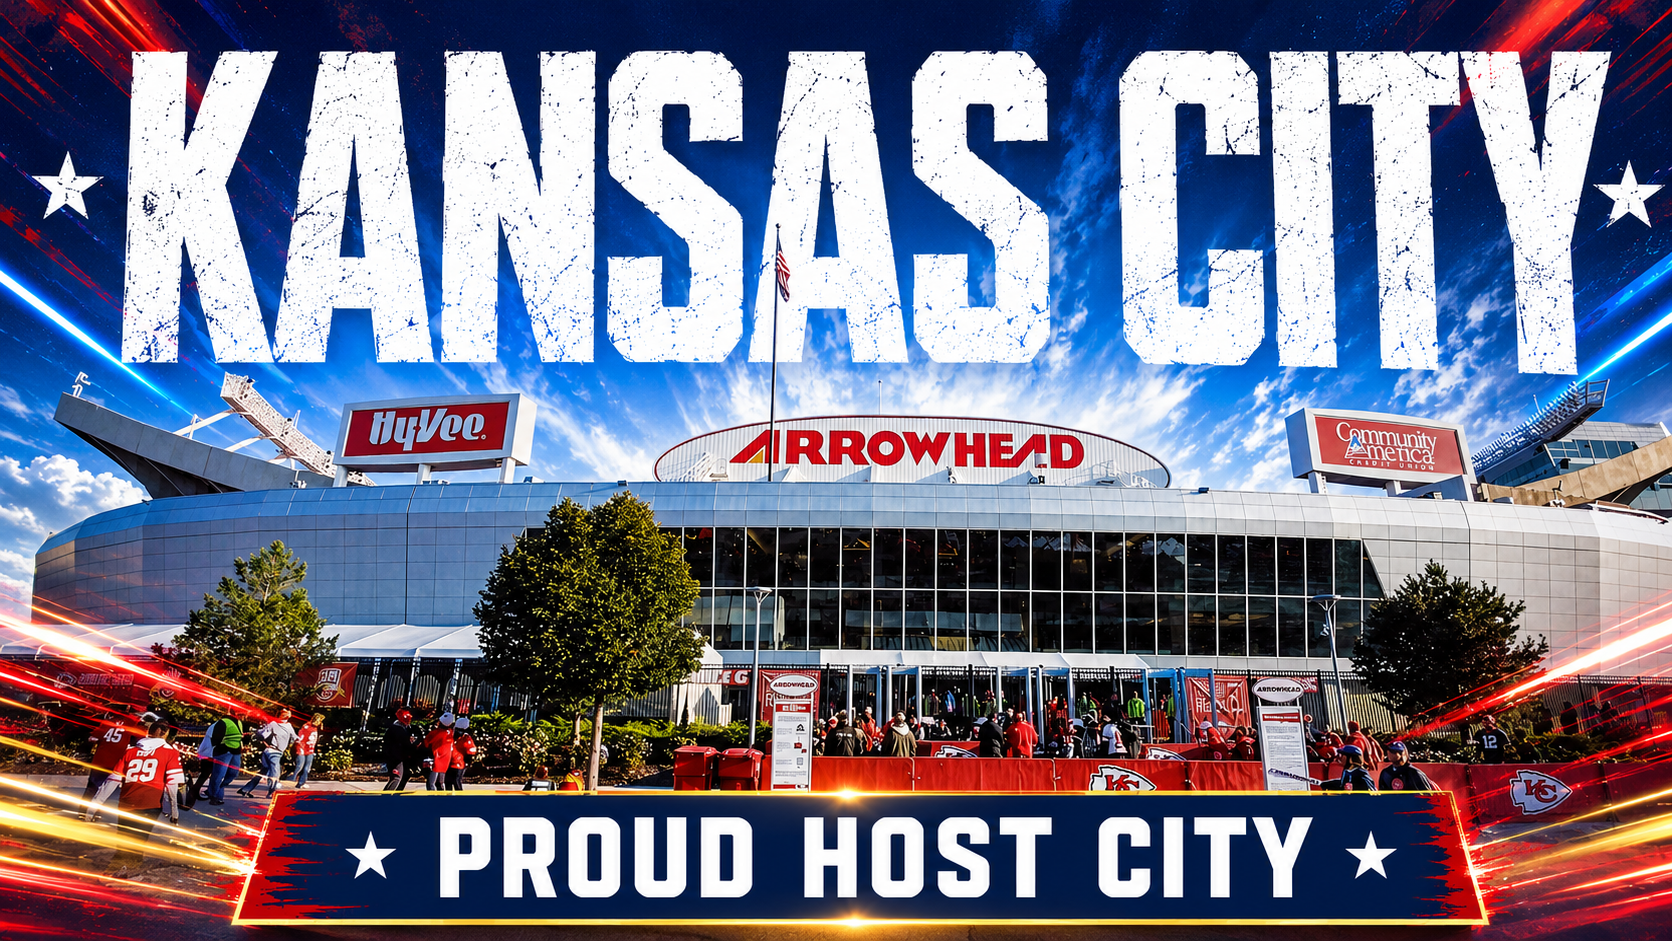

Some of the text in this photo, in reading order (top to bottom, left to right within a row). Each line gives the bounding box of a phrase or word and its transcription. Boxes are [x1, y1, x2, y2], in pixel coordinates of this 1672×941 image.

[729, 429, 1085, 469] ARROWHEAD
[1336, 422, 1437, 456] Community
[1345, 434, 1434, 464] America
[1349, 458, 1434, 471] CREDIT UNION
[103, 727, 125, 743] 45
[1482, 735, 1498, 749] 12
[126, 759, 158, 782] 29
[1524, 780, 1557, 803] KC
